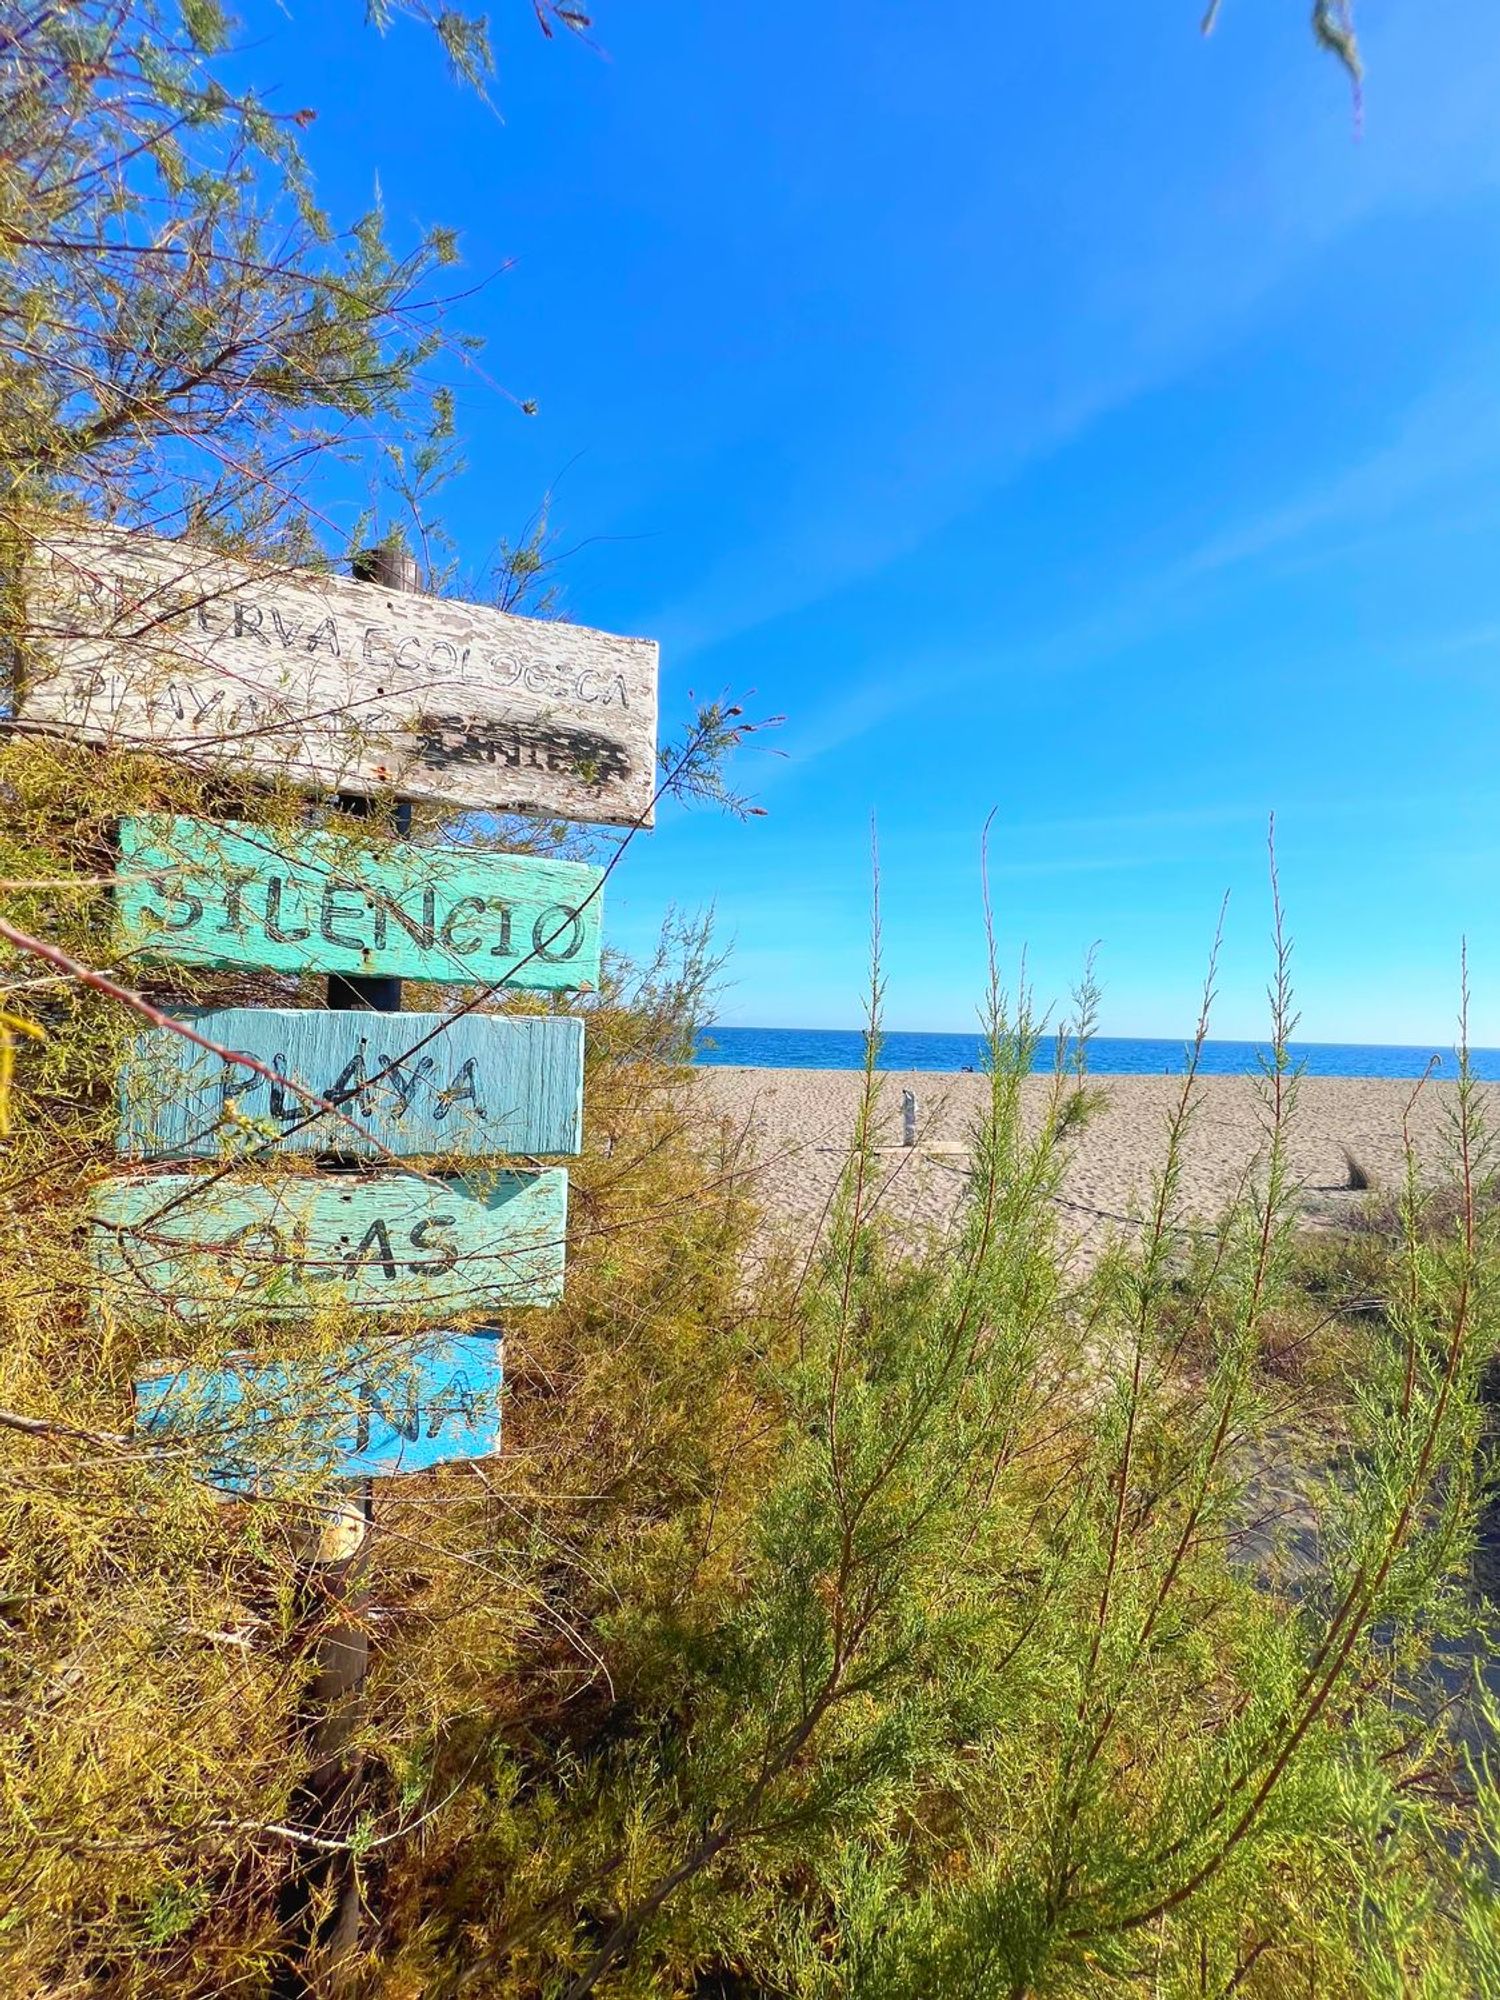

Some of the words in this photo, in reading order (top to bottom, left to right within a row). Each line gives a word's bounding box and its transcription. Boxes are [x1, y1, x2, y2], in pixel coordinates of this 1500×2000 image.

[139, 868, 585, 963] SILENCIO
[221, 1050, 488, 1122] PLAYA
[217, 1214, 460, 1290] OLAS
